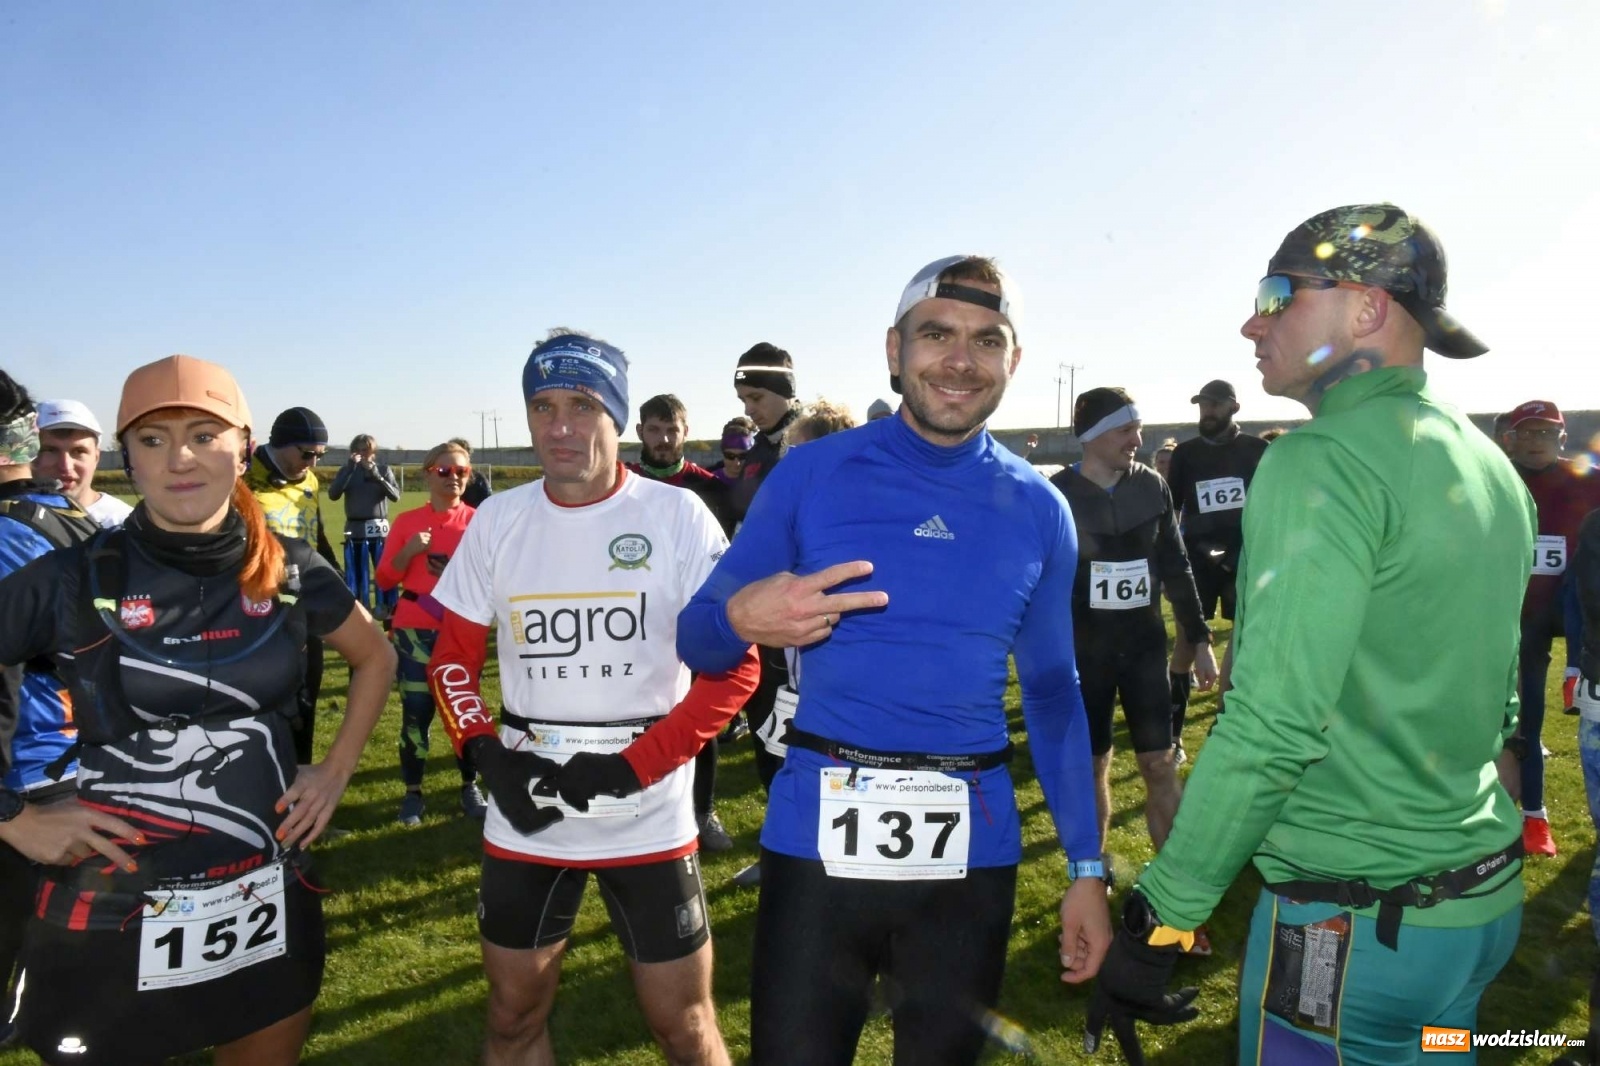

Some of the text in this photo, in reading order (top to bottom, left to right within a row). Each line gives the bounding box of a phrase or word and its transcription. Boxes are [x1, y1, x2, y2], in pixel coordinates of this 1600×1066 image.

[1200, 487, 1243, 506] 162
[367, 525, 388, 534] 220
[913, 527, 955, 540] adidas
[1095, 576, 1149, 600] 164
[519, 591, 647, 659] agrol
[526, 662, 634, 680] KIETRZ
[839, 746, 902, 764] performance
[875, 782, 963, 794] www.personalbest.pl
[831, 807, 961, 860] 137
[157, 879, 224, 891] prformance
[154, 902, 278, 970] 152
